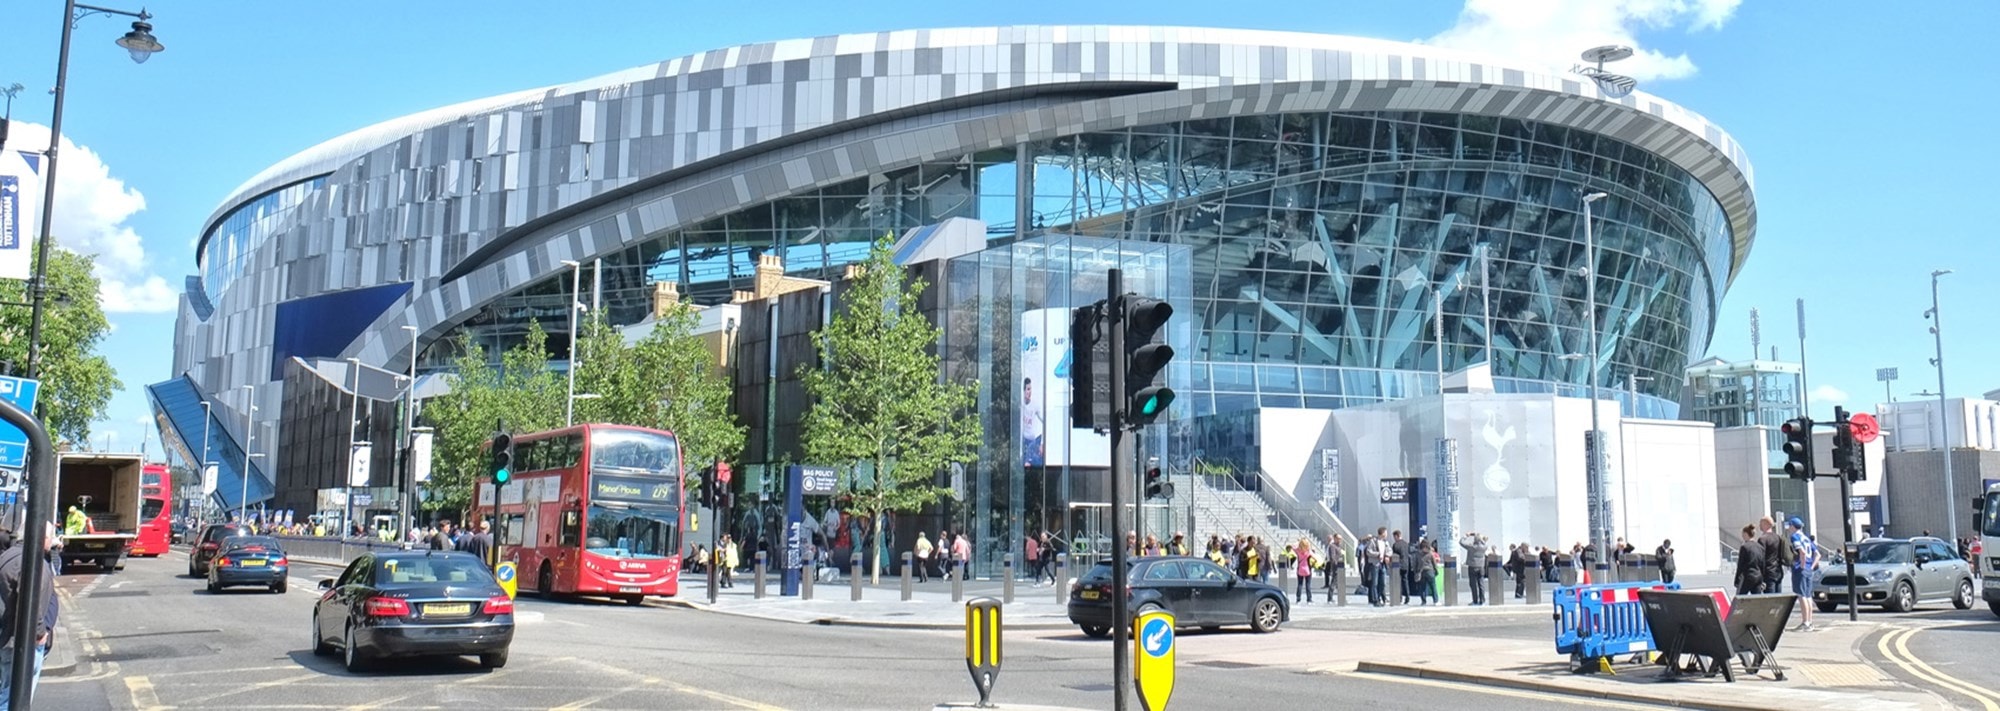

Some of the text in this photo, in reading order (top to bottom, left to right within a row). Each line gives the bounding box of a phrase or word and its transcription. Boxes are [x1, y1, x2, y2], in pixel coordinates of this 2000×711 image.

[4, 196, 13, 246] TOTTENHAM
[815, 469, 834, 477] POLICY
[598, 484, 618, 493] Manor
[620, 486, 641, 495] House
